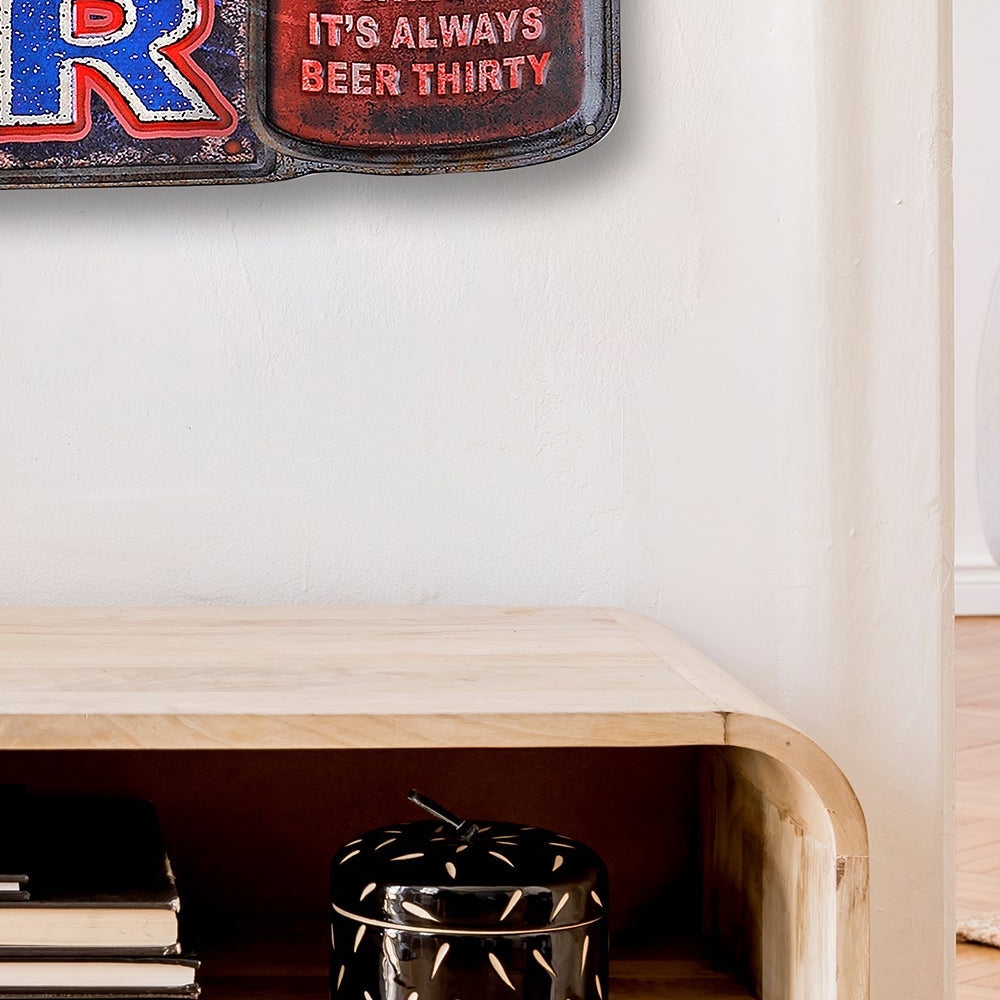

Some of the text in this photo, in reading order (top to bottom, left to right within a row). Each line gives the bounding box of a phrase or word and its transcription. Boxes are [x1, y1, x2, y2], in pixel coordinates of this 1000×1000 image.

[308, 6, 545, 49] IT'S ALWAYS
[301, 51, 552, 96] BEER THIRTY
